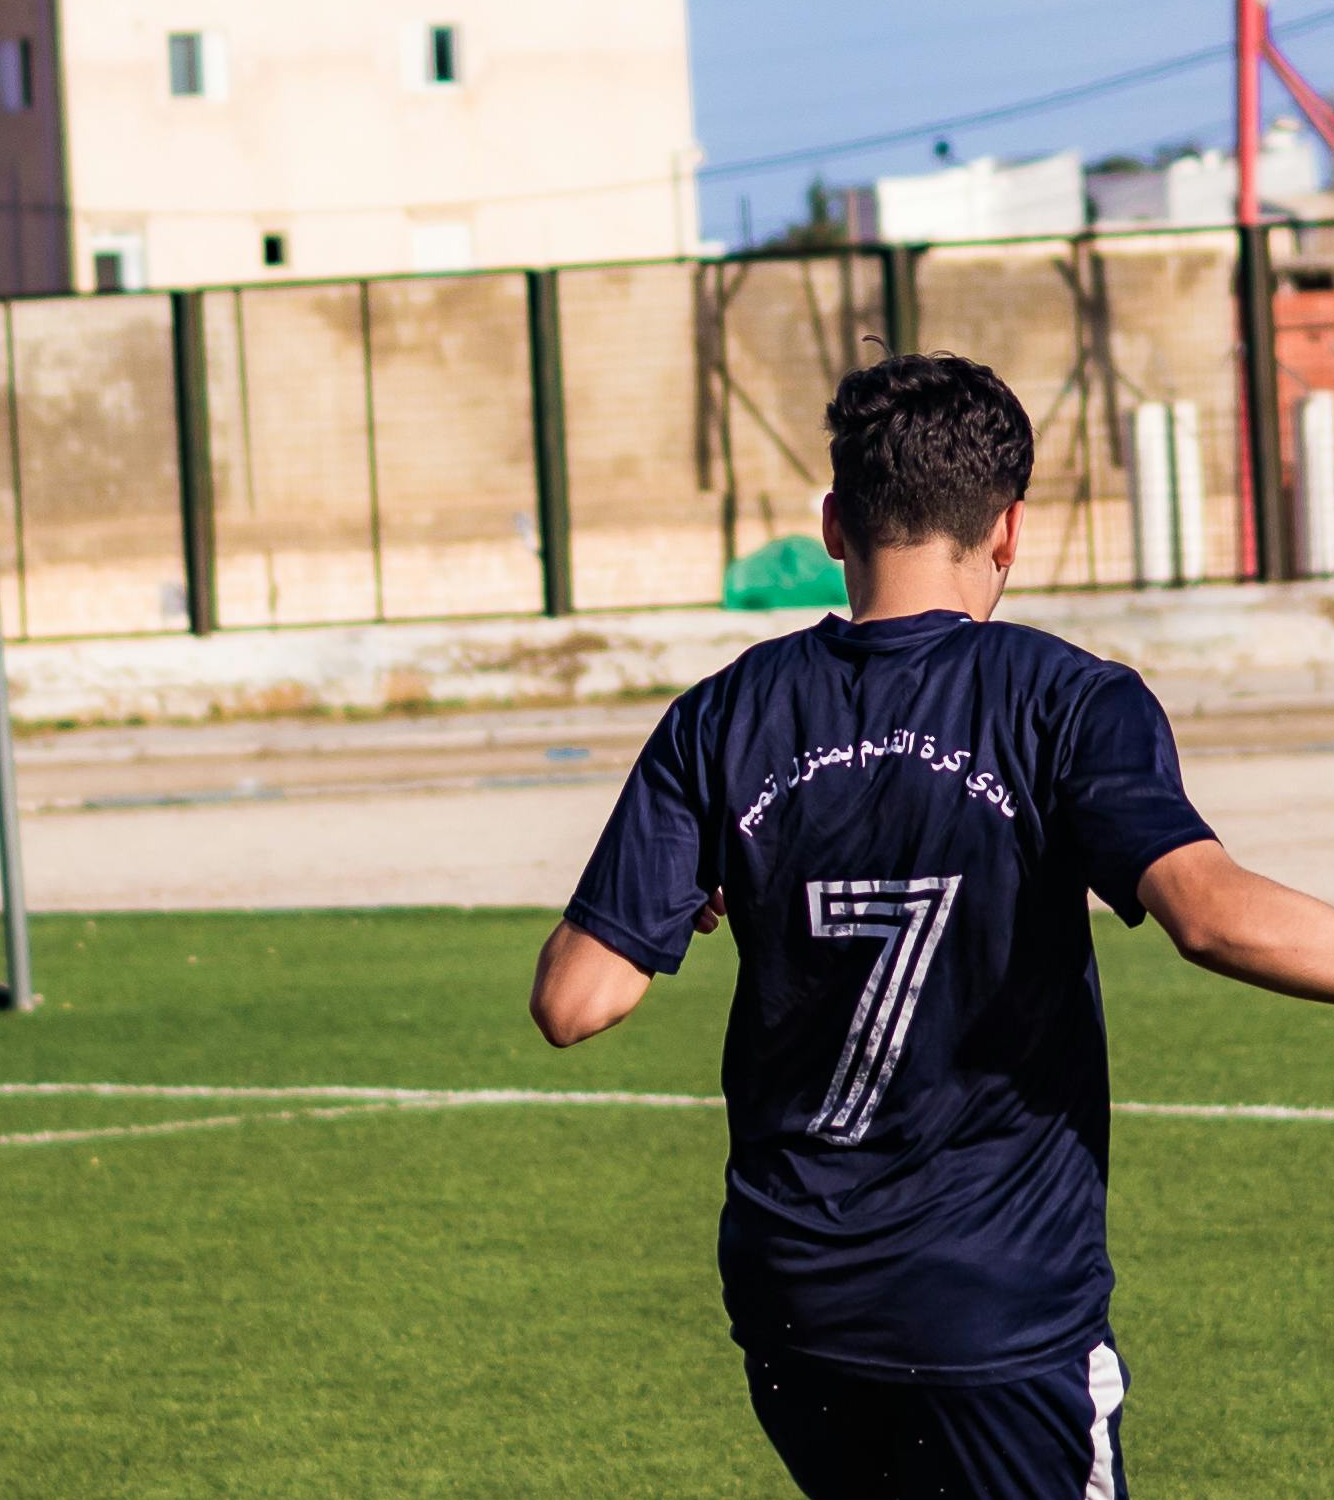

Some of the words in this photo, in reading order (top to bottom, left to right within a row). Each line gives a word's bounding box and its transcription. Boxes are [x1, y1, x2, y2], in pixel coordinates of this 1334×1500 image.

[786, 743, 855, 788] بمنزل
[859, 728, 915, 767] القدم
[922, 734, 971, 772] كرة
[739, 772, 779, 837] تميم
[807, 875, 962, 1143] 7
